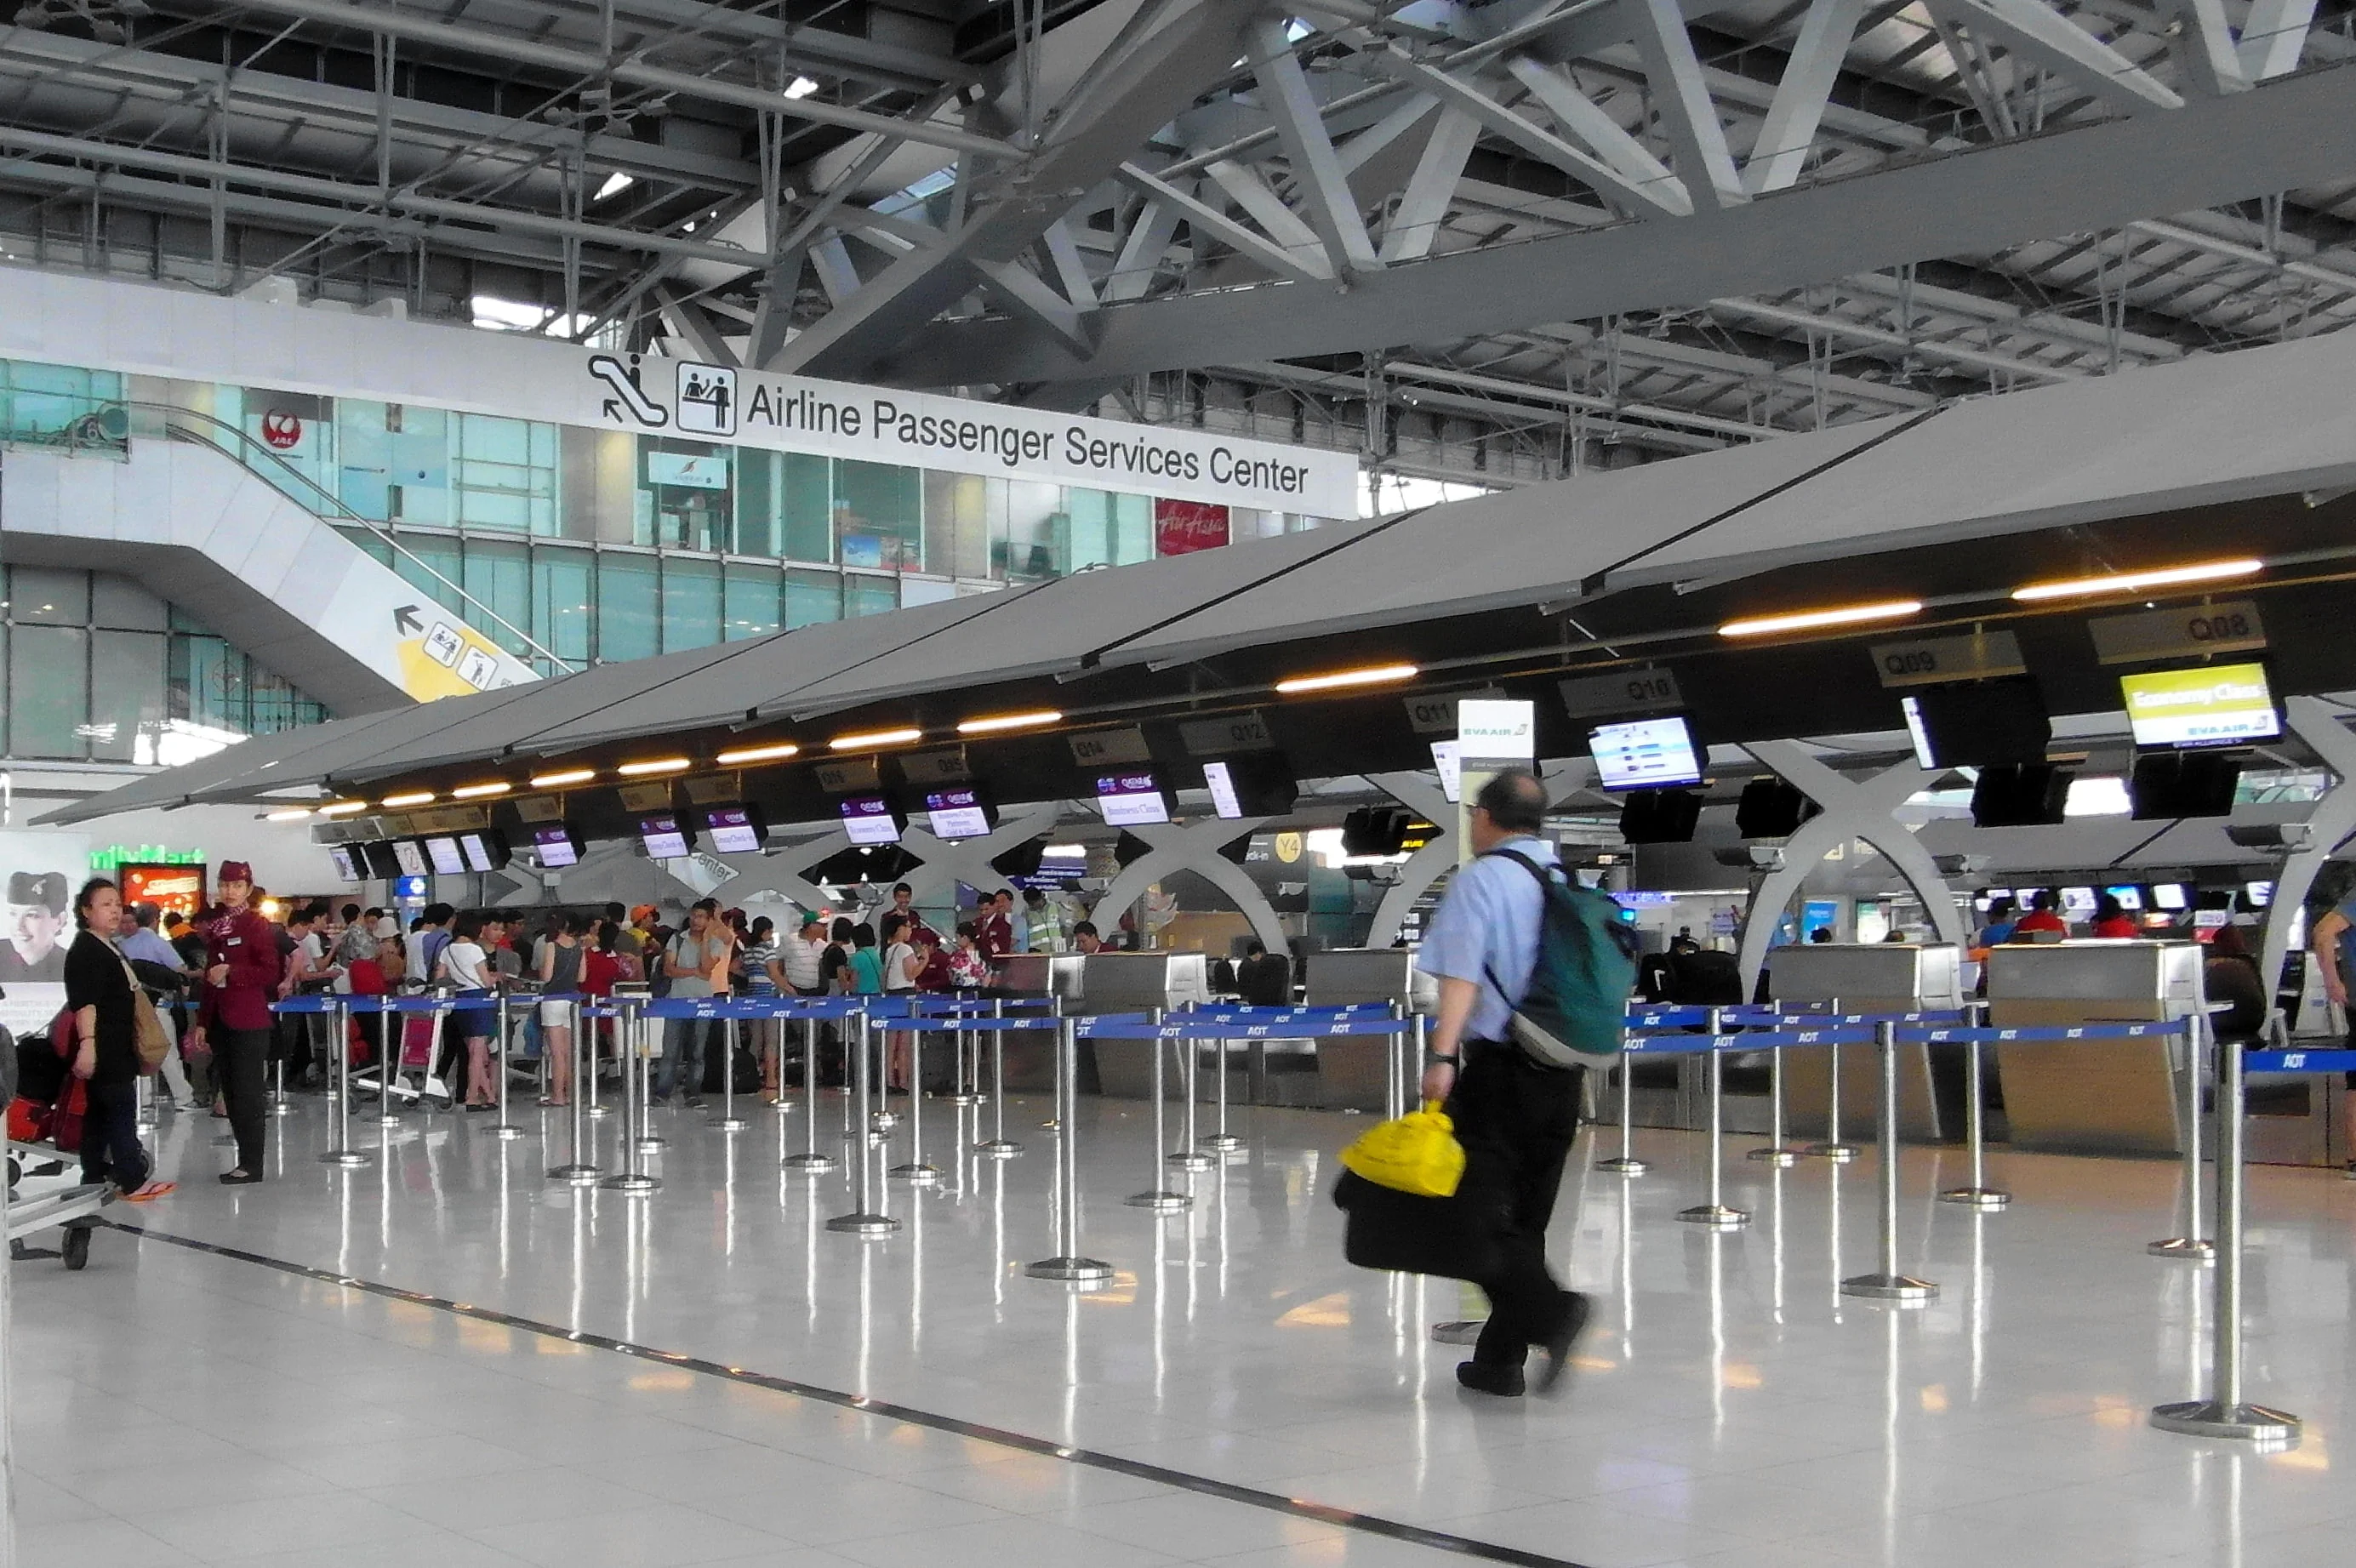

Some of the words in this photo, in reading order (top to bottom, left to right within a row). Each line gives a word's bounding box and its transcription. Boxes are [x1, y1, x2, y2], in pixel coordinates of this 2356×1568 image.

[272, 436, 294, 445] JAL
[747, 384, 861, 436] Airline
[874, 399, 1054, 467] Passenger
[1066, 426, 1199, 482] Services
[1209, 448, 1309, 494] Center
[2188, 614, 2249, 640] Q08
[1885, 652, 1935, 675] Q09
[2132, 690, 2212, 708] Economy
[2215, 683, 2267, 699] Class
[1416, 703, 1451, 723] Q11
[2188, 727, 2220, 736] EVA
[2222, 724, 2249, 733] AIR
[1280, 837, 1299, 855] Y4
[692, 853, 731, 881] enter
[601, 1007, 617, 1016] AOT
[697, 1009, 716, 1018] AOT
[1160, 1028, 1182, 1036] AOT
[1247, 1027, 1269, 1035] AOT
[1331, 1024, 1350, 1034] AOT
[2000, 1029, 2017, 1039] AOT
[2068, 1029, 2082, 1037] AOT
[2130, 1026, 2144, 1035] AOT
[1799, 1032, 1819, 1042] AOT
[1931, 1030, 1949, 1040] AOT
[1623, 1039, 1646, 1049] AOT
[1714, 1036, 1735, 1047] AOT
[2283, 1054, 2306, 1069] AOT
